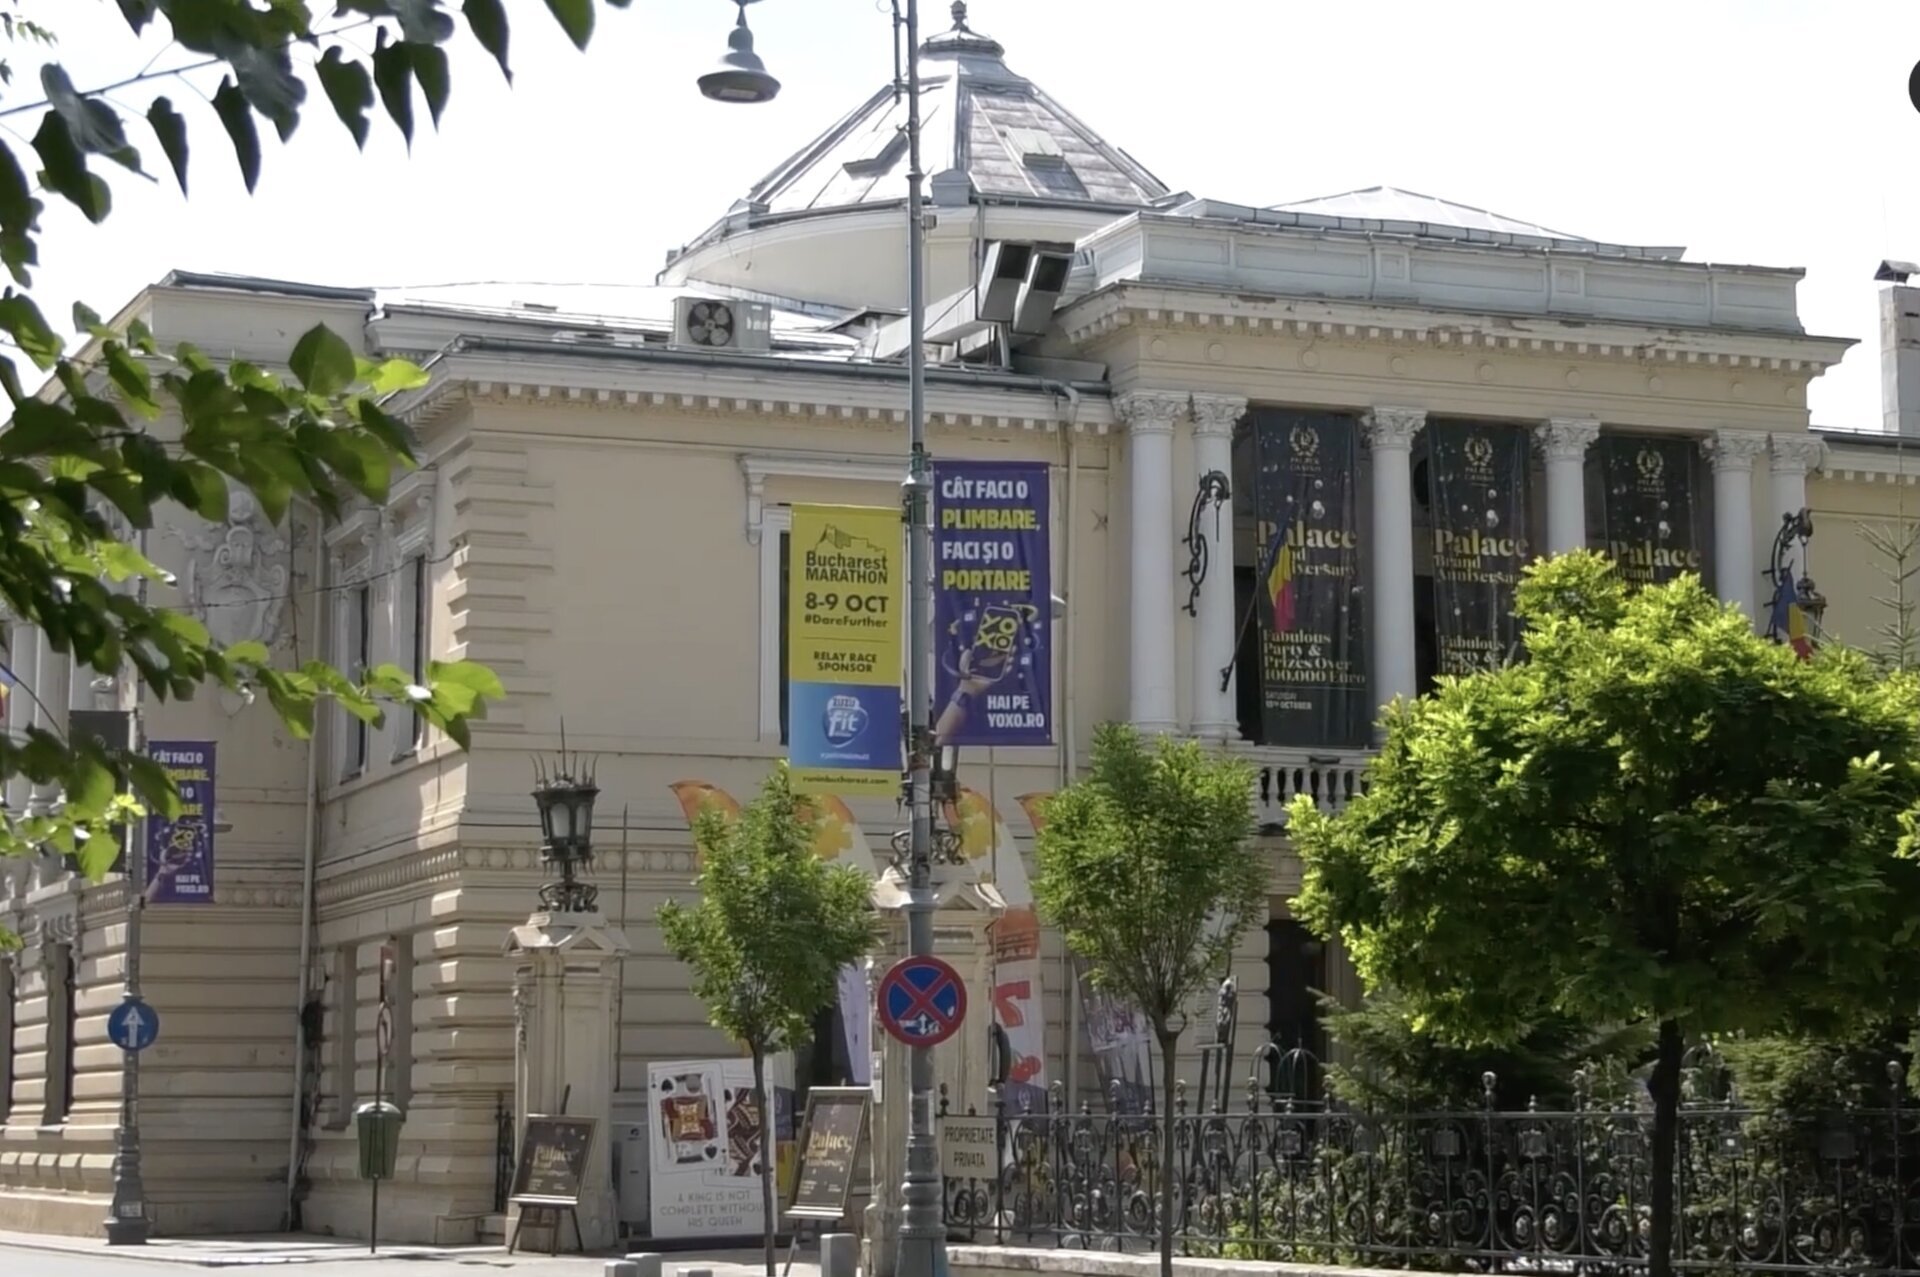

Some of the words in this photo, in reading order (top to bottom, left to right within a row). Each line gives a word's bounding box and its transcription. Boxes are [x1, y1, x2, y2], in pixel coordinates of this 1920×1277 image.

[942, 476, 974, 499] CÂT
[976, 480, 1013, 499] FACI
[1016, 480, 1028, 499] O
[942, 508, 1041, 531] PLIMBARE,
[1435, 528, 1529, 558] Palace
[942, 541, 979, 560] FACI
[982, 541, 998, 564] ȘI
[1001, 541, 1014, 560] O
[1610, 539, 1700, 568] Palace
[806, 551, 888, 570] Bucharest
[1433, 554, 1481, 569] Brand
[806, 567, 888, 584] MARATHON
[943, 570, 1031, 591] PORTARE
[805, 592, 838, 611] 8-9
[845, 594, 889, 613] OCT
[804, 613, 888, 628] #DareFurther
[1263, 629, 1331, 643] Fabulous
[813, 651, 847, 662] RELAY
[849, 653, 877, 664] RACE
[1264, 642, 1303, 660] Party
[1308, 644, 1321, 657] &
[817, 662, 873, 672] SPONSOR
[1264, 656, 1312, 669] Prizes
[1315, 657, 1352, 670] Over
[1265, 669, 1327, 682] 100.000
[1329, 670, 1366, 683] Euro
[987, 695, 1010, 710] HAI
[1012, 695, 1030, 710] PE
[987, 713, 1045, 728] YOXO.RO
[945, 1126, 994, 1144] PROPRIETATE
[688, 1192, 712, 1202] KING
[716, 1191, 723, 1201] IS
[728, 1190, 751, 1201] NOT
[660, 1204, 715, 1216] COMPLETE
[720, 1202, 764, 1214] WITHOU
[688, 1218, 703, 1228] HIS
[708, 1216, 743, 1227] QUEEN
